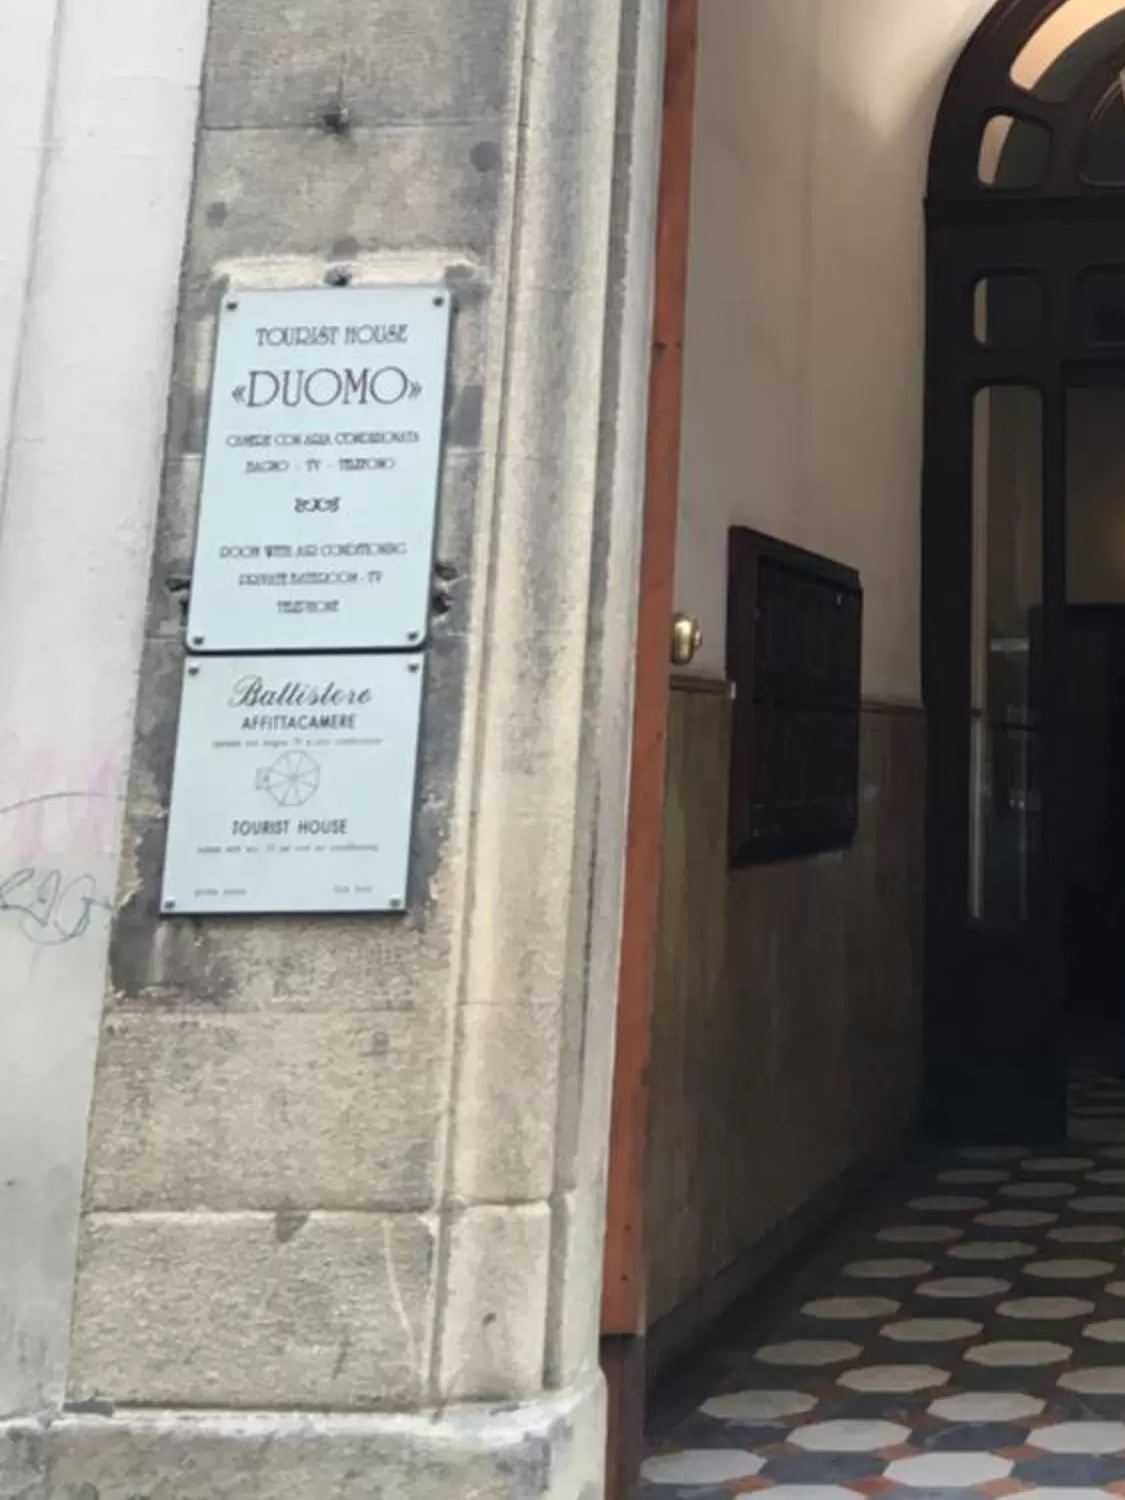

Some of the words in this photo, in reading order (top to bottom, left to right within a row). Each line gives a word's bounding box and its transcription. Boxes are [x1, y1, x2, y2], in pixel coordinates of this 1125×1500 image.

[255, 325, 340, 347] TOURIST
[343, 323, 409, 345] HOUSE
[240, 712, 357, 731] AFFITTACAMERE
[231, 819, 289, 837] TOURIST
[296, 818, 349, 836] HOUSE
